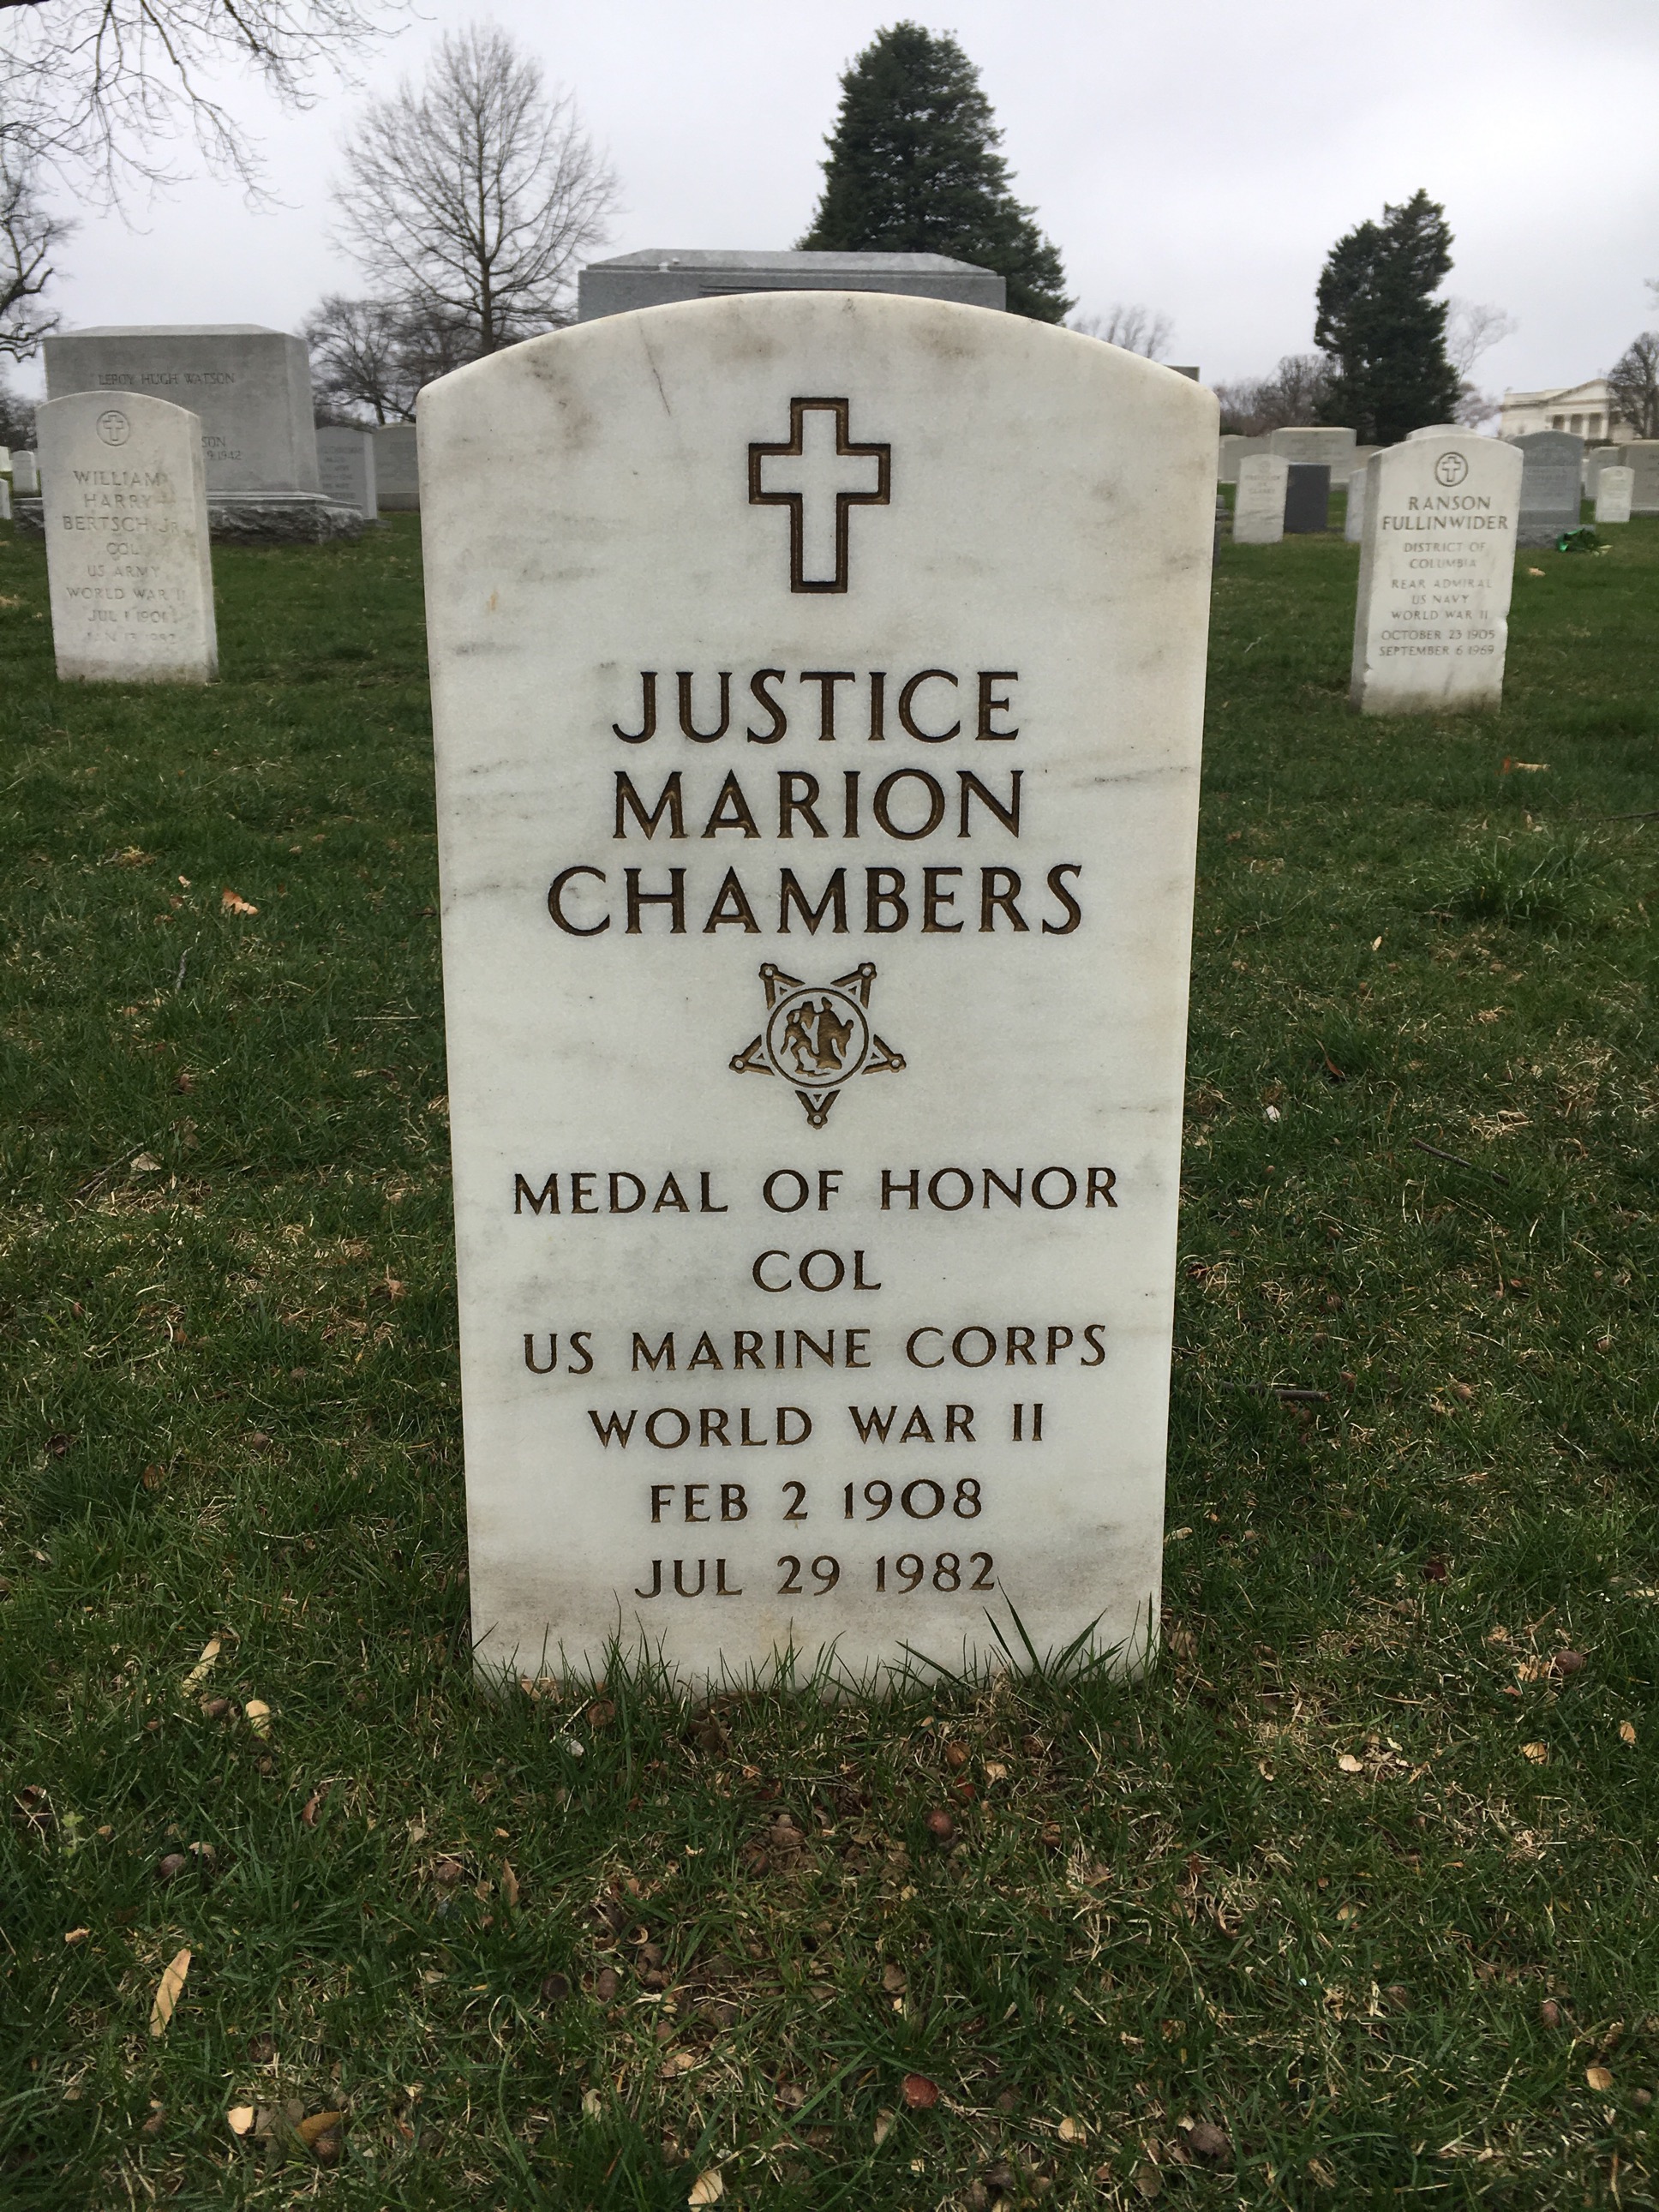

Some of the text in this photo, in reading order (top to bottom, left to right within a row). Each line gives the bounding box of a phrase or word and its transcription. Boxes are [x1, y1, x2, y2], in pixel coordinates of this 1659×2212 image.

[99, 373, 235, 386] LEROY HUGH WATSON
[73, 471, 164, 487] WILLIAM
[84, 494, 152, 509] HARRY
[1408, 495, 1491, 511] RANSON
[63, 516, 149, 532] BERTSCH
[1382, 515, 1509, 531] FULLINWIDER
[106, 542, 140, 555] COL
[1404, 542, 1487, 554] DISTRICT OF
[87, 565, 162, 578] US ARMY
[1409, 558, 1477, 570] COLUMBIA
[1392, 578, 1493, 590] REAR ADMIRAL
[66, 586, 125, 601] WORLD
[133, 588, 167, 602] WAR
[1412, 594, 1470, 605] US NAVY
[88, 609, 117, 622] JUL
[1391, 609, 1488, 621] WORLD WAR II
[1381, 629, 1496, 641] OCTOBER 23 1905
[1379, 644, 1495, 657] SEPTEMBER 6 1969
[611, 668, 1020, 745] JUSTICE
[612, 767, 1025, 842] MARION
[547, 863, 1082, 938] CHAMBERS
[513, 1166, 1118, 1216] MEDAL OF HONOR
[752, 1249, 882, 1293] COL
[523, 1323, 1106, 1375] US MARINE CORPS
[587, 1403, 1044, 1450] WORLD WAR II
[650, 1478, 982, 1524] FEB 2 1908
[634, 1551, 996, 1599] JUL 29 1982
